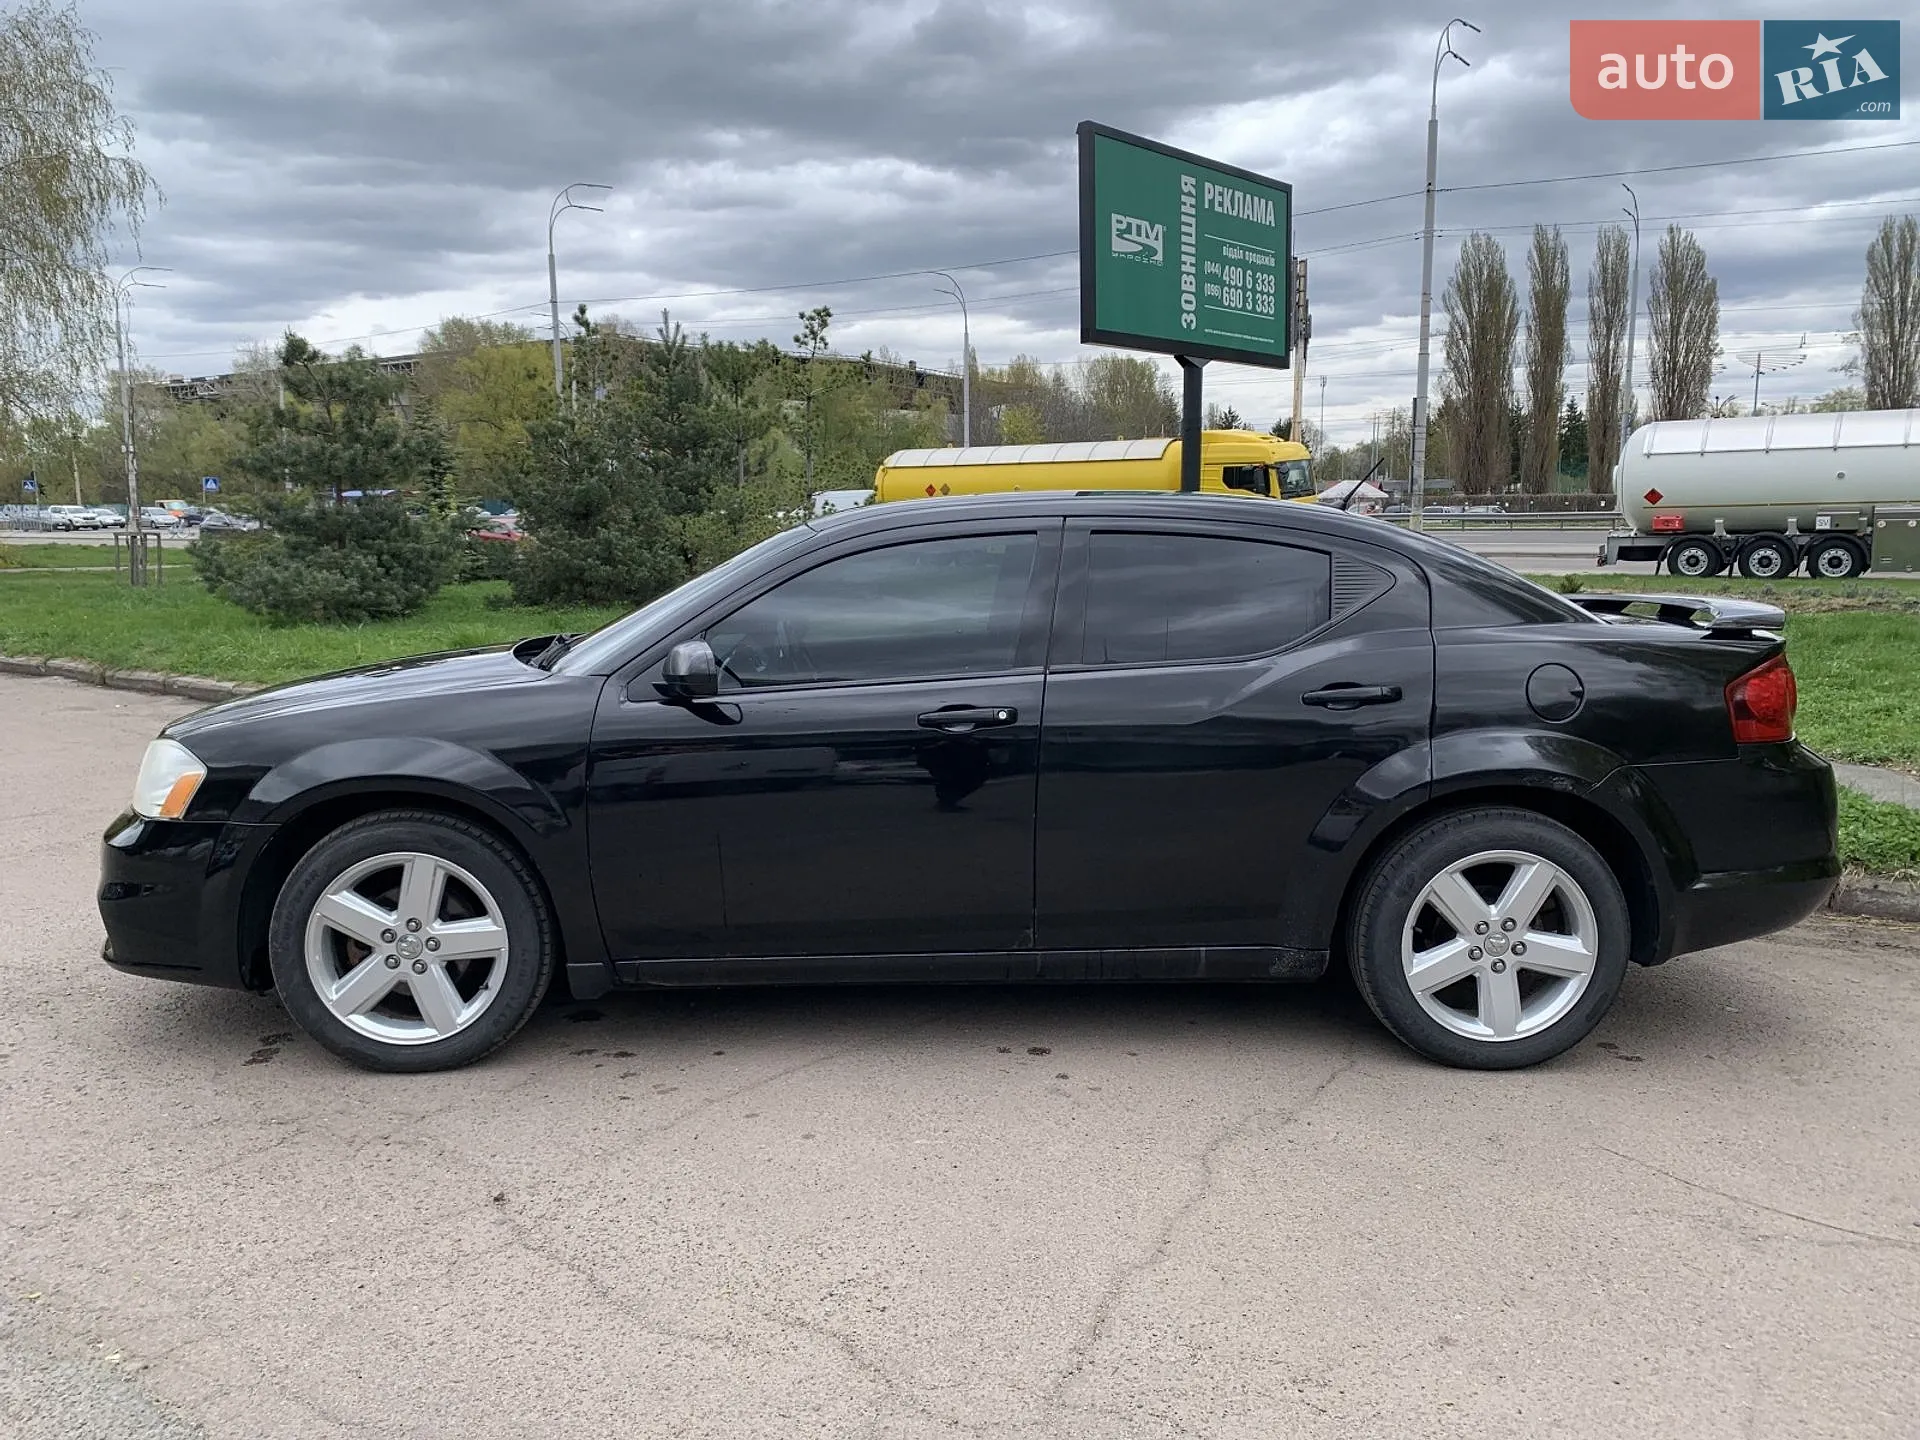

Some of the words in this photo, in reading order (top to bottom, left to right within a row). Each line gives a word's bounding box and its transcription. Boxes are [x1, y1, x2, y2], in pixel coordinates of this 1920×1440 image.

[1204, 181, 1276, 227] РЕКЛАМА
[1180, 174, 1197, 330] ЗОВНІШНЯ
[1223, 265, 1243, 287] 490
[1246, 270, 1253, 289] 6
[1255, 272, 1275, 294] 333
[1223, 286, 1243, 308] 690
[1245, 291, 1253, 310] 3
[1255, 293, 1275, 315] 333
